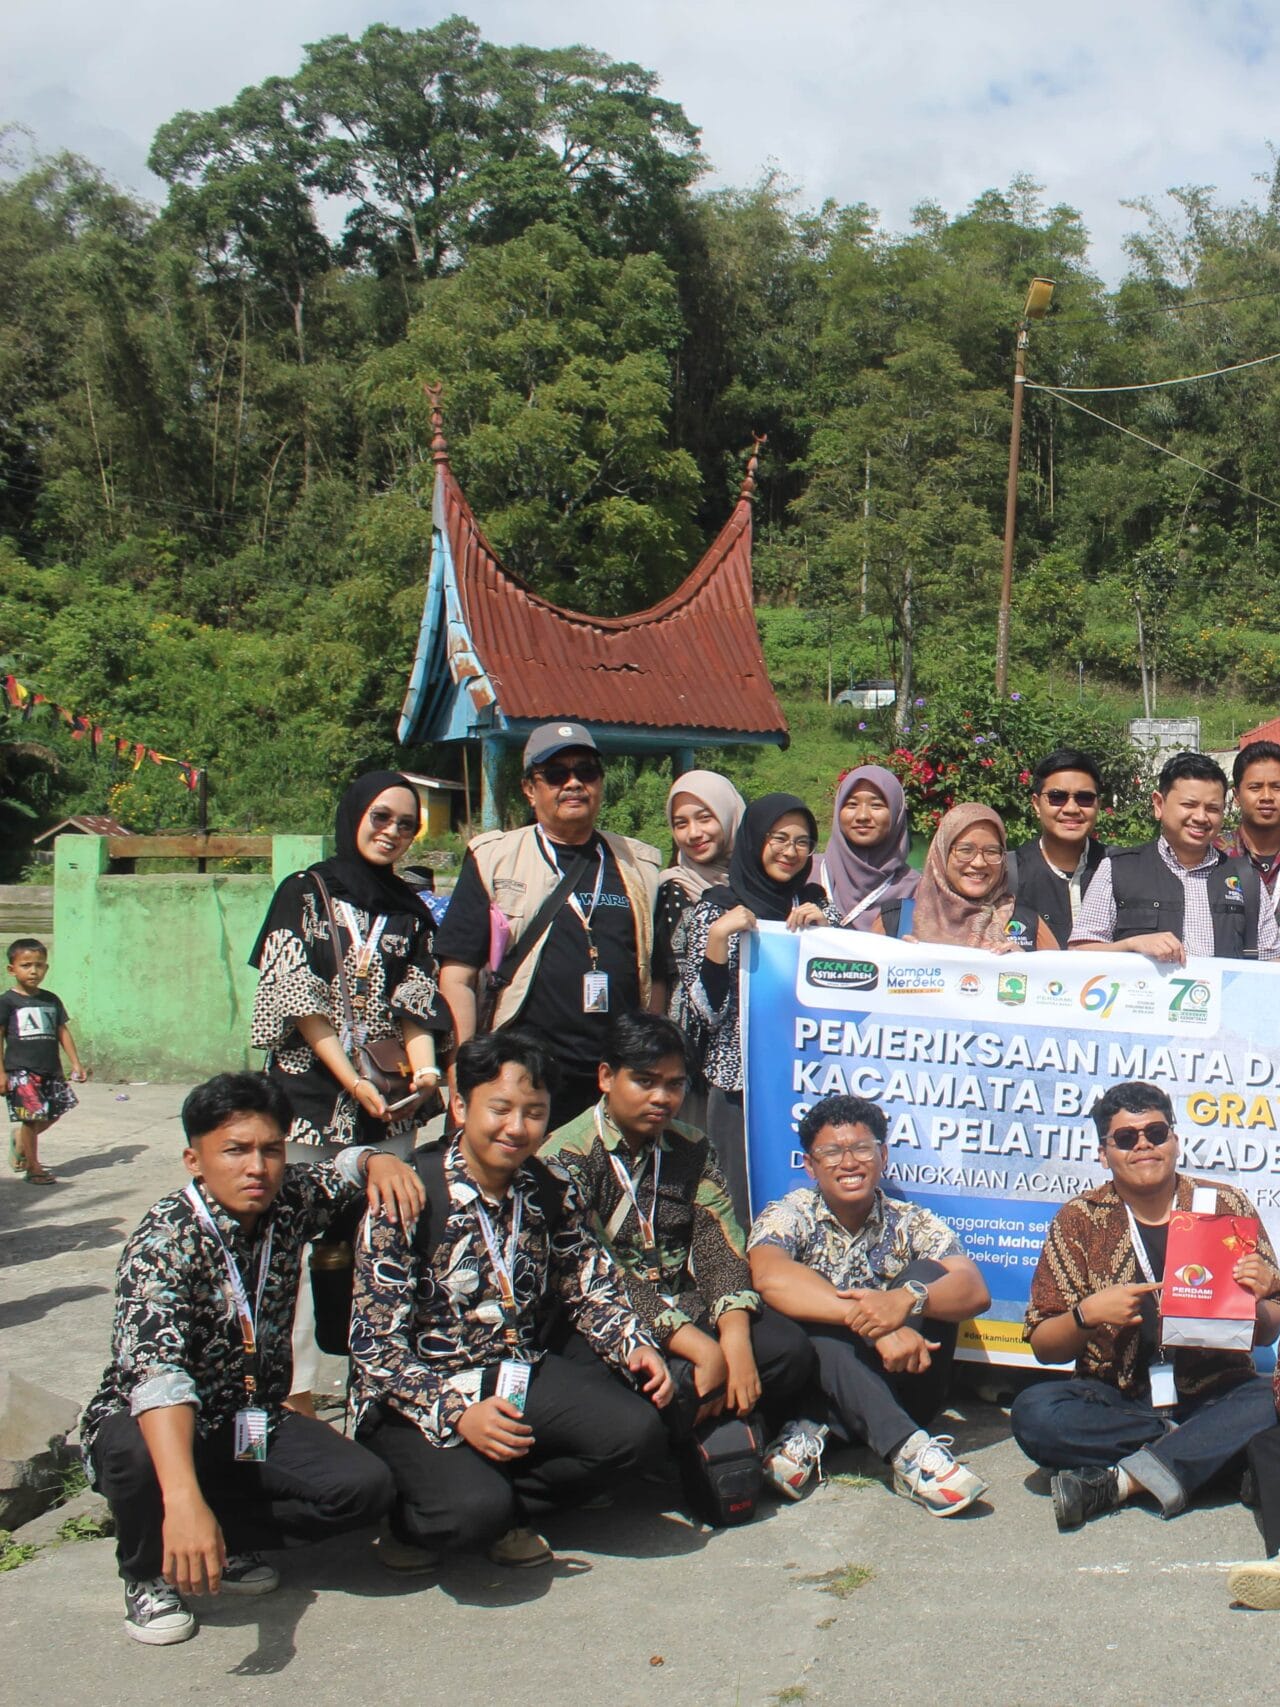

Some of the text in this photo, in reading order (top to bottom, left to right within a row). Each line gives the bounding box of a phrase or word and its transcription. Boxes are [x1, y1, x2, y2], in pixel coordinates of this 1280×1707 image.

[812, 961, 875, 972] KKN KU
[888, 966, 942, 979] Kampus
[811, 970, 836, 979] ASTIK
[887, 977, 945, 988] Merdeka
[795, 1016, 1099, 1076] PEMERIKSAAN
[1107, 1042, 1233, 1085] MATA
[793, 1059, 1045, 1115] KACAMATA
[931, 1115, 1101, 1163] PELATIH
[1014, 1171, 1095, 1194] ACARA
[964, 1232, 994, 1246] oleh
[966, 1248, 1018, 1268] bekerja
[1171, 1286, 1213, 1295] PERDAMI
